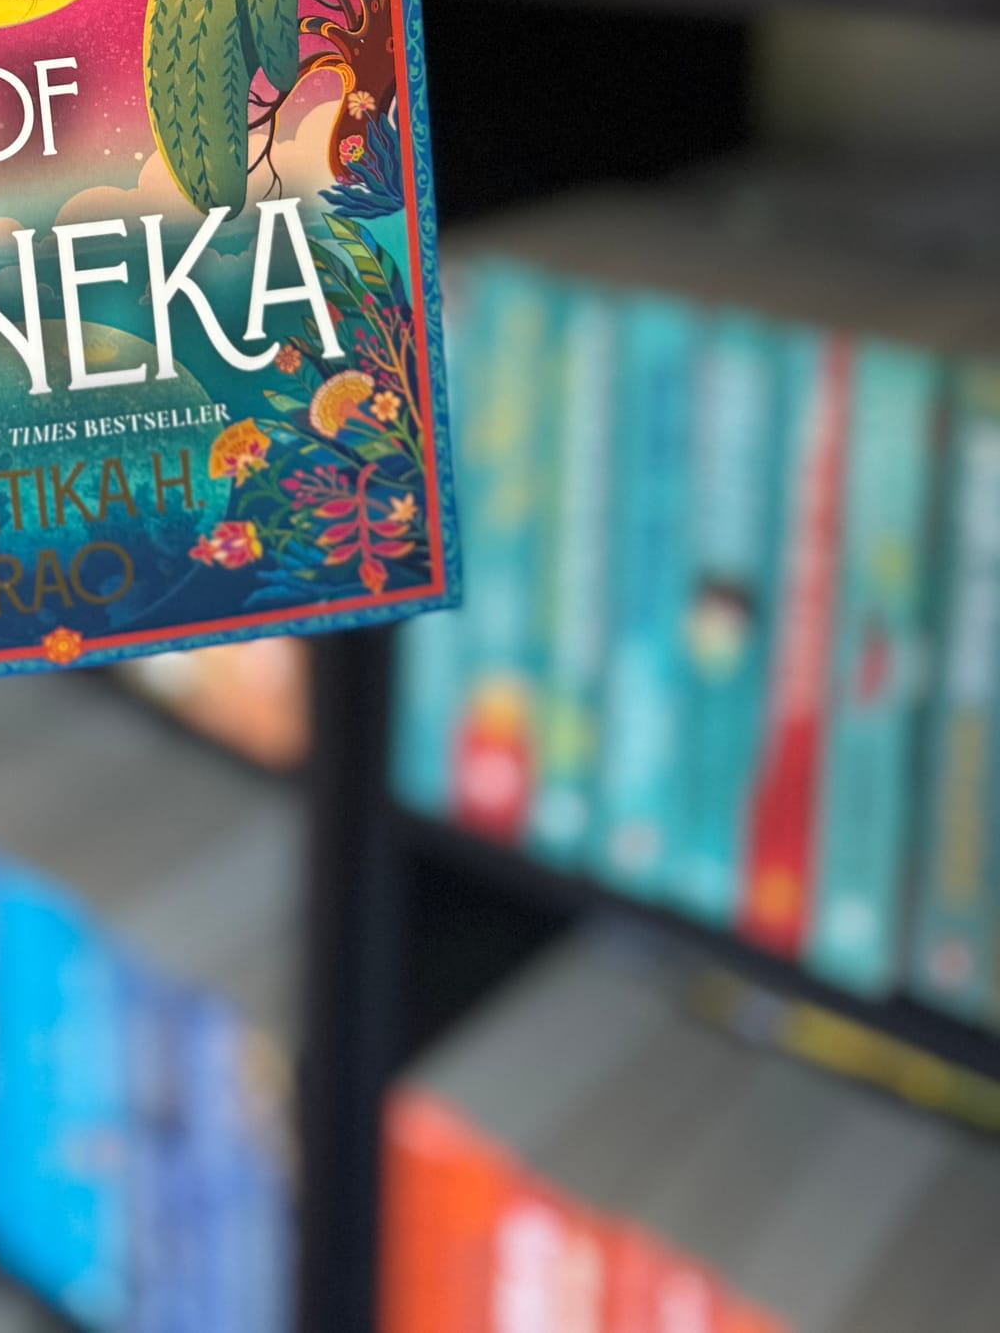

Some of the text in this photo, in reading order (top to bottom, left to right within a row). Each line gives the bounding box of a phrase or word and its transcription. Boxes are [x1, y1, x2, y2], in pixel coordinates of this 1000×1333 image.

[8, 421, 77, 448] TIMES
[84, 403, 231, 439] BESTSELLER
[151, 449, 206, 513] H.
